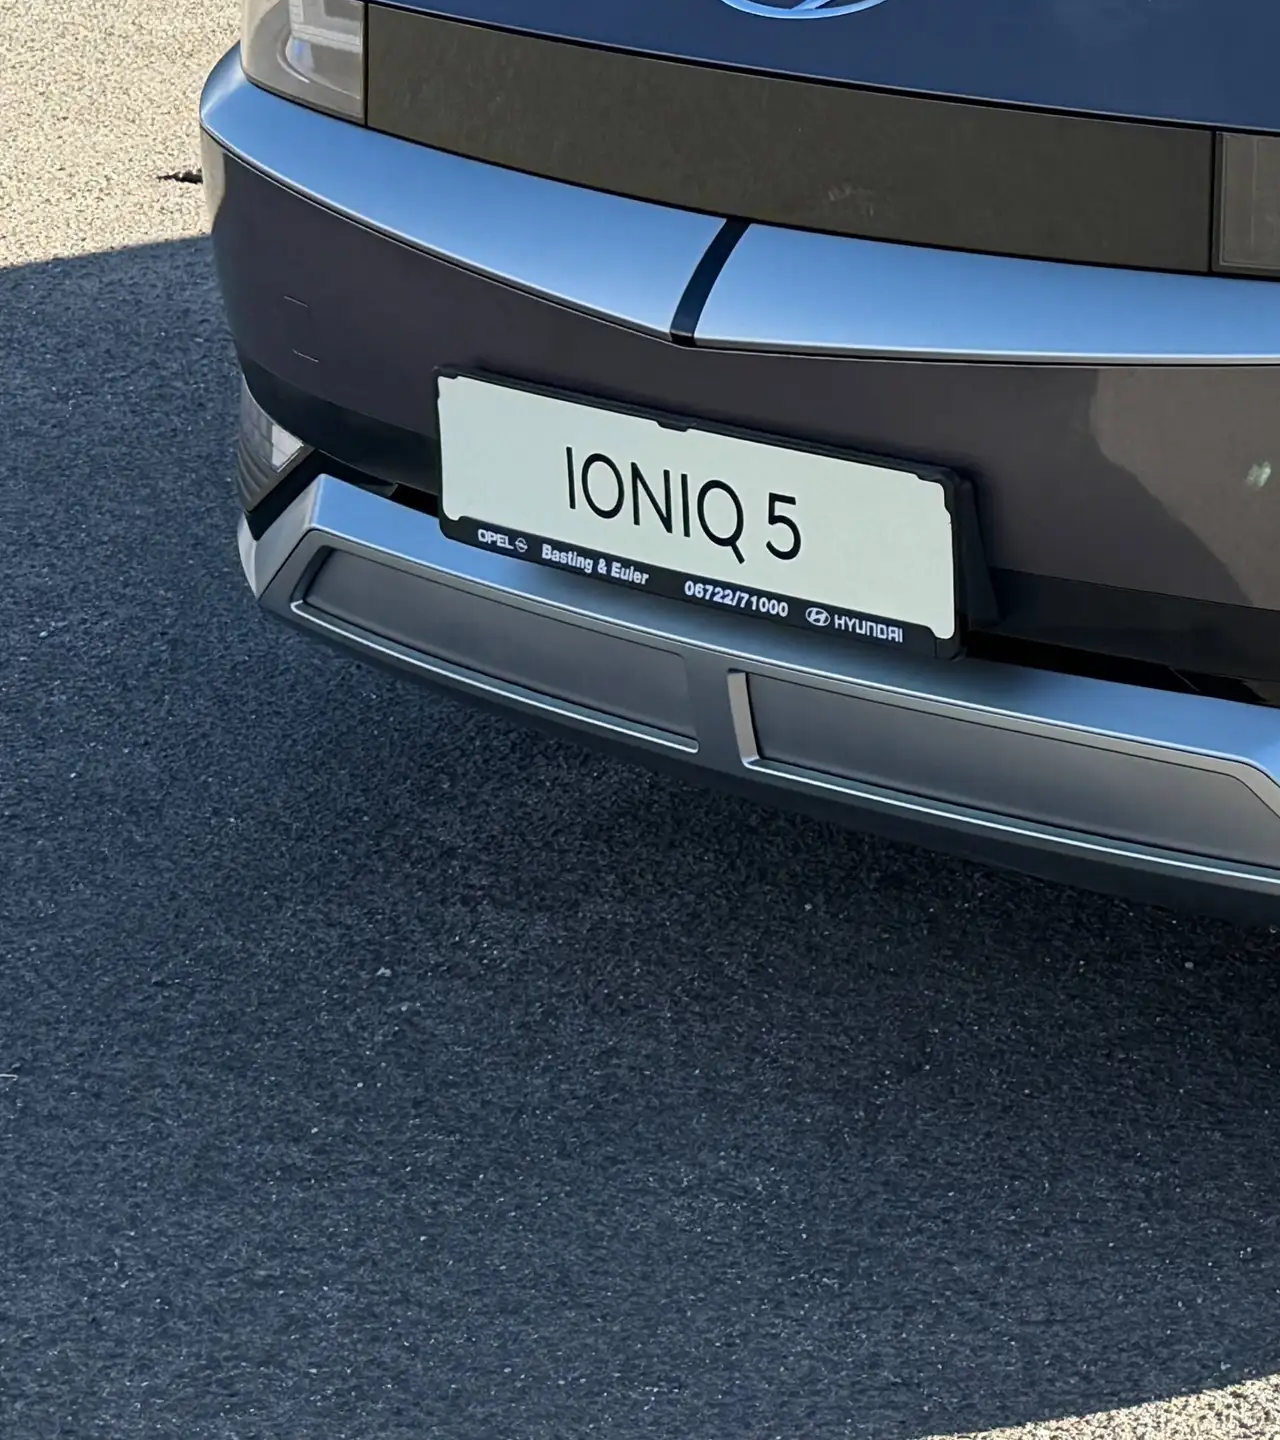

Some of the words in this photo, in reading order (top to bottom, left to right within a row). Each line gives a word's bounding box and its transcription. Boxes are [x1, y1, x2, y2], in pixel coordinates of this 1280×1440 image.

[565, 445, 747, 566] IONIQ
[764, 491, 803, 561] 5
[477, 528, 515, 550] OPEL
[541, 542, 595, 574] Basting
[597, 558, 608, 575] &
[610, 561, 650, 586] Euler
[683, 580, 789, 618] 06722/71000
[834, 614, 904, 643] HYUNDAI
